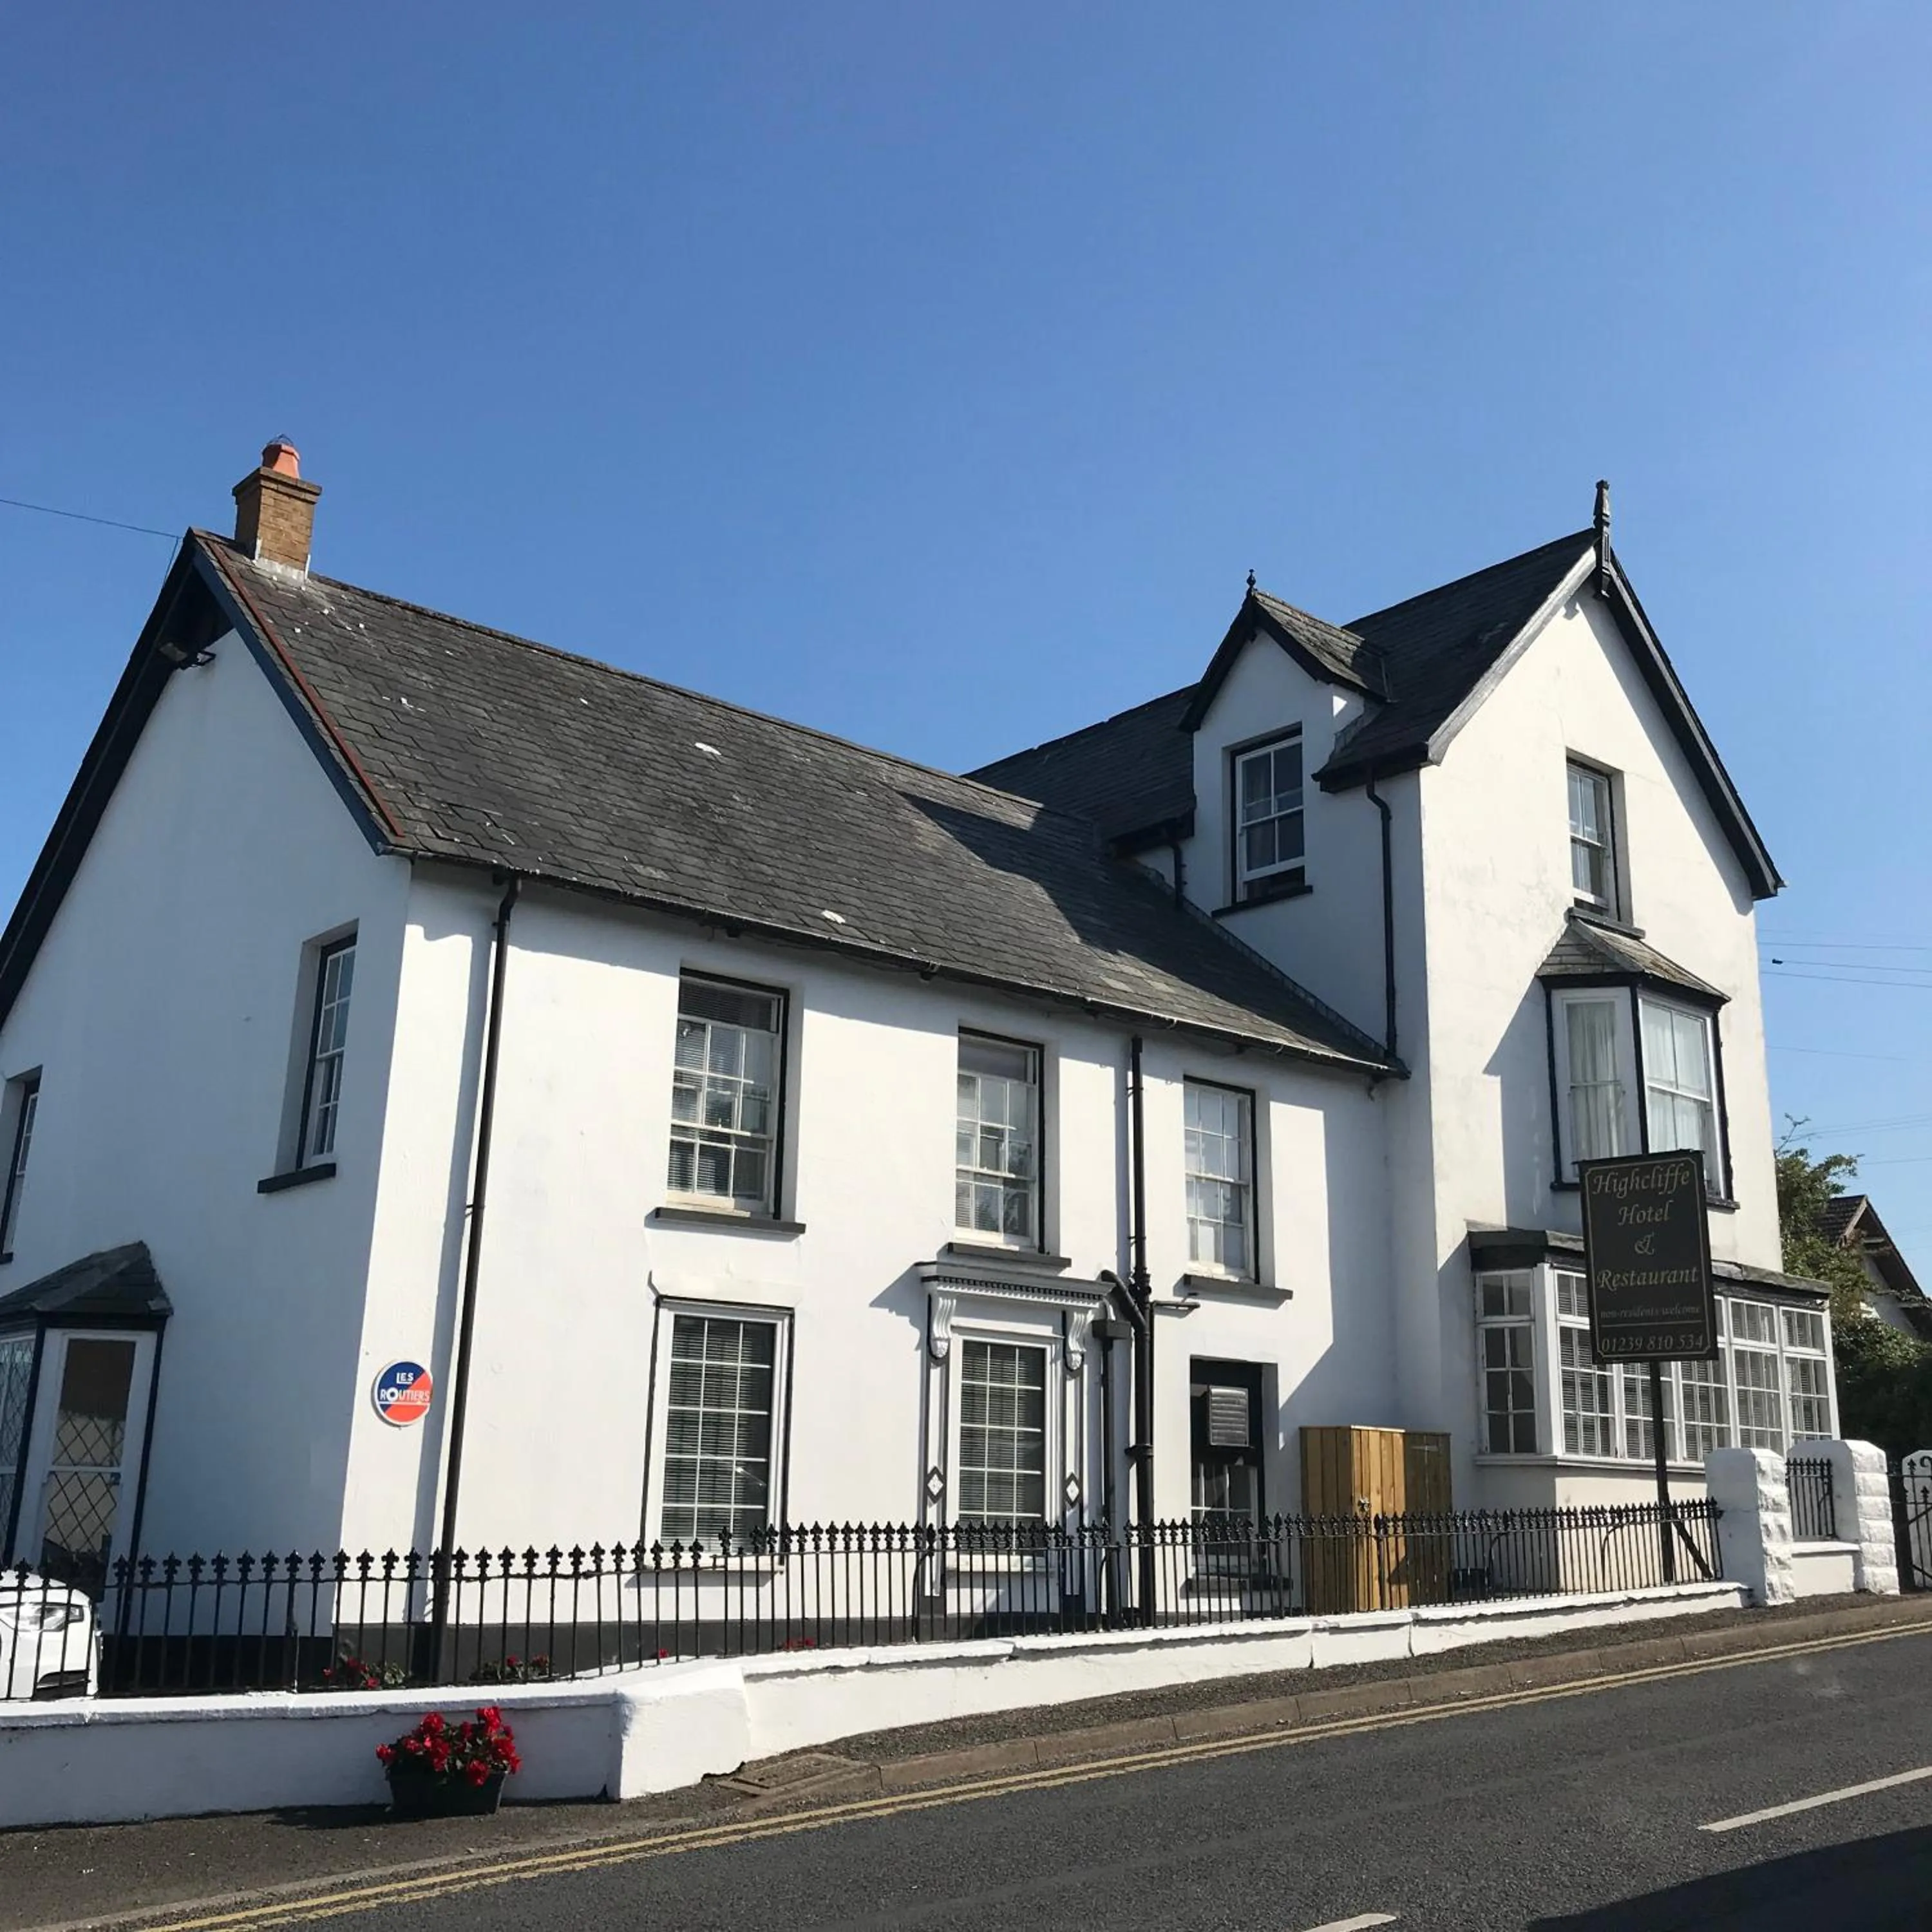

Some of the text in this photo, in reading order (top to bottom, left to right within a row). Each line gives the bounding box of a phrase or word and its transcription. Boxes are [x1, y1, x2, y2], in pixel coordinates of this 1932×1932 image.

[1592, 1163, 1690, 1198] Highcliffe
[1618, 1200, 1674, 1226] Hotel
[1634, 1231, 1655, 1255] &
[1596, 1266, 1700, 1291] Restaurant
[1662, 1304, 1701, 1316] welcome
[1602, 1333, 1703, 1352] 01239 810 534
[396, 1372, 414, 1384] LES
[379, 1387, 430, 1402] ROUTIERS
